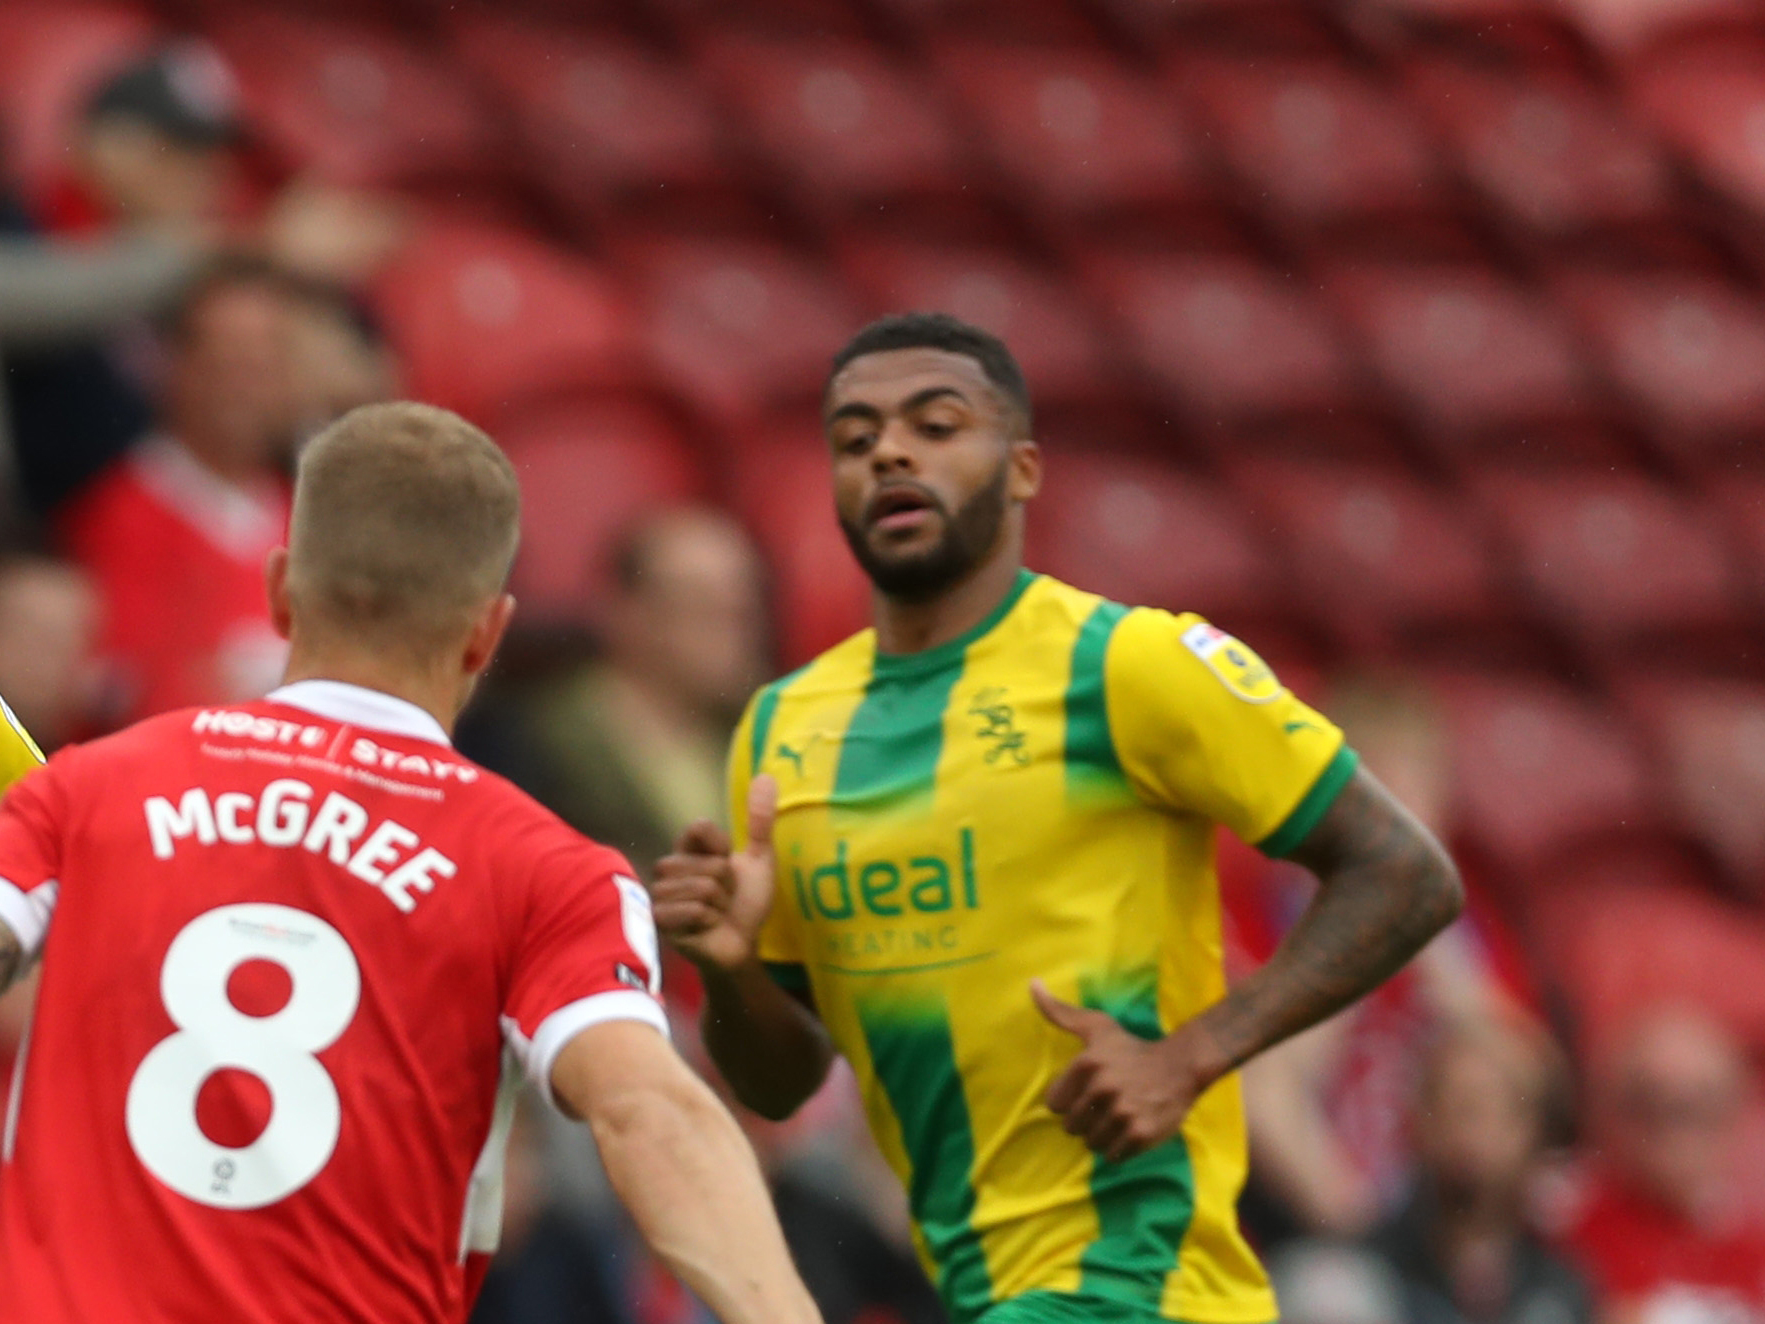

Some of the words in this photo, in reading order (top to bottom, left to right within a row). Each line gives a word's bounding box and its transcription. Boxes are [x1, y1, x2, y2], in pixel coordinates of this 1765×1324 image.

[350, 737, 456, 780] STAY
[144, 778, 456, 913] McGREE
[792, 826, 980, 922] ideal
[127, 903, 360, 1209] 8
